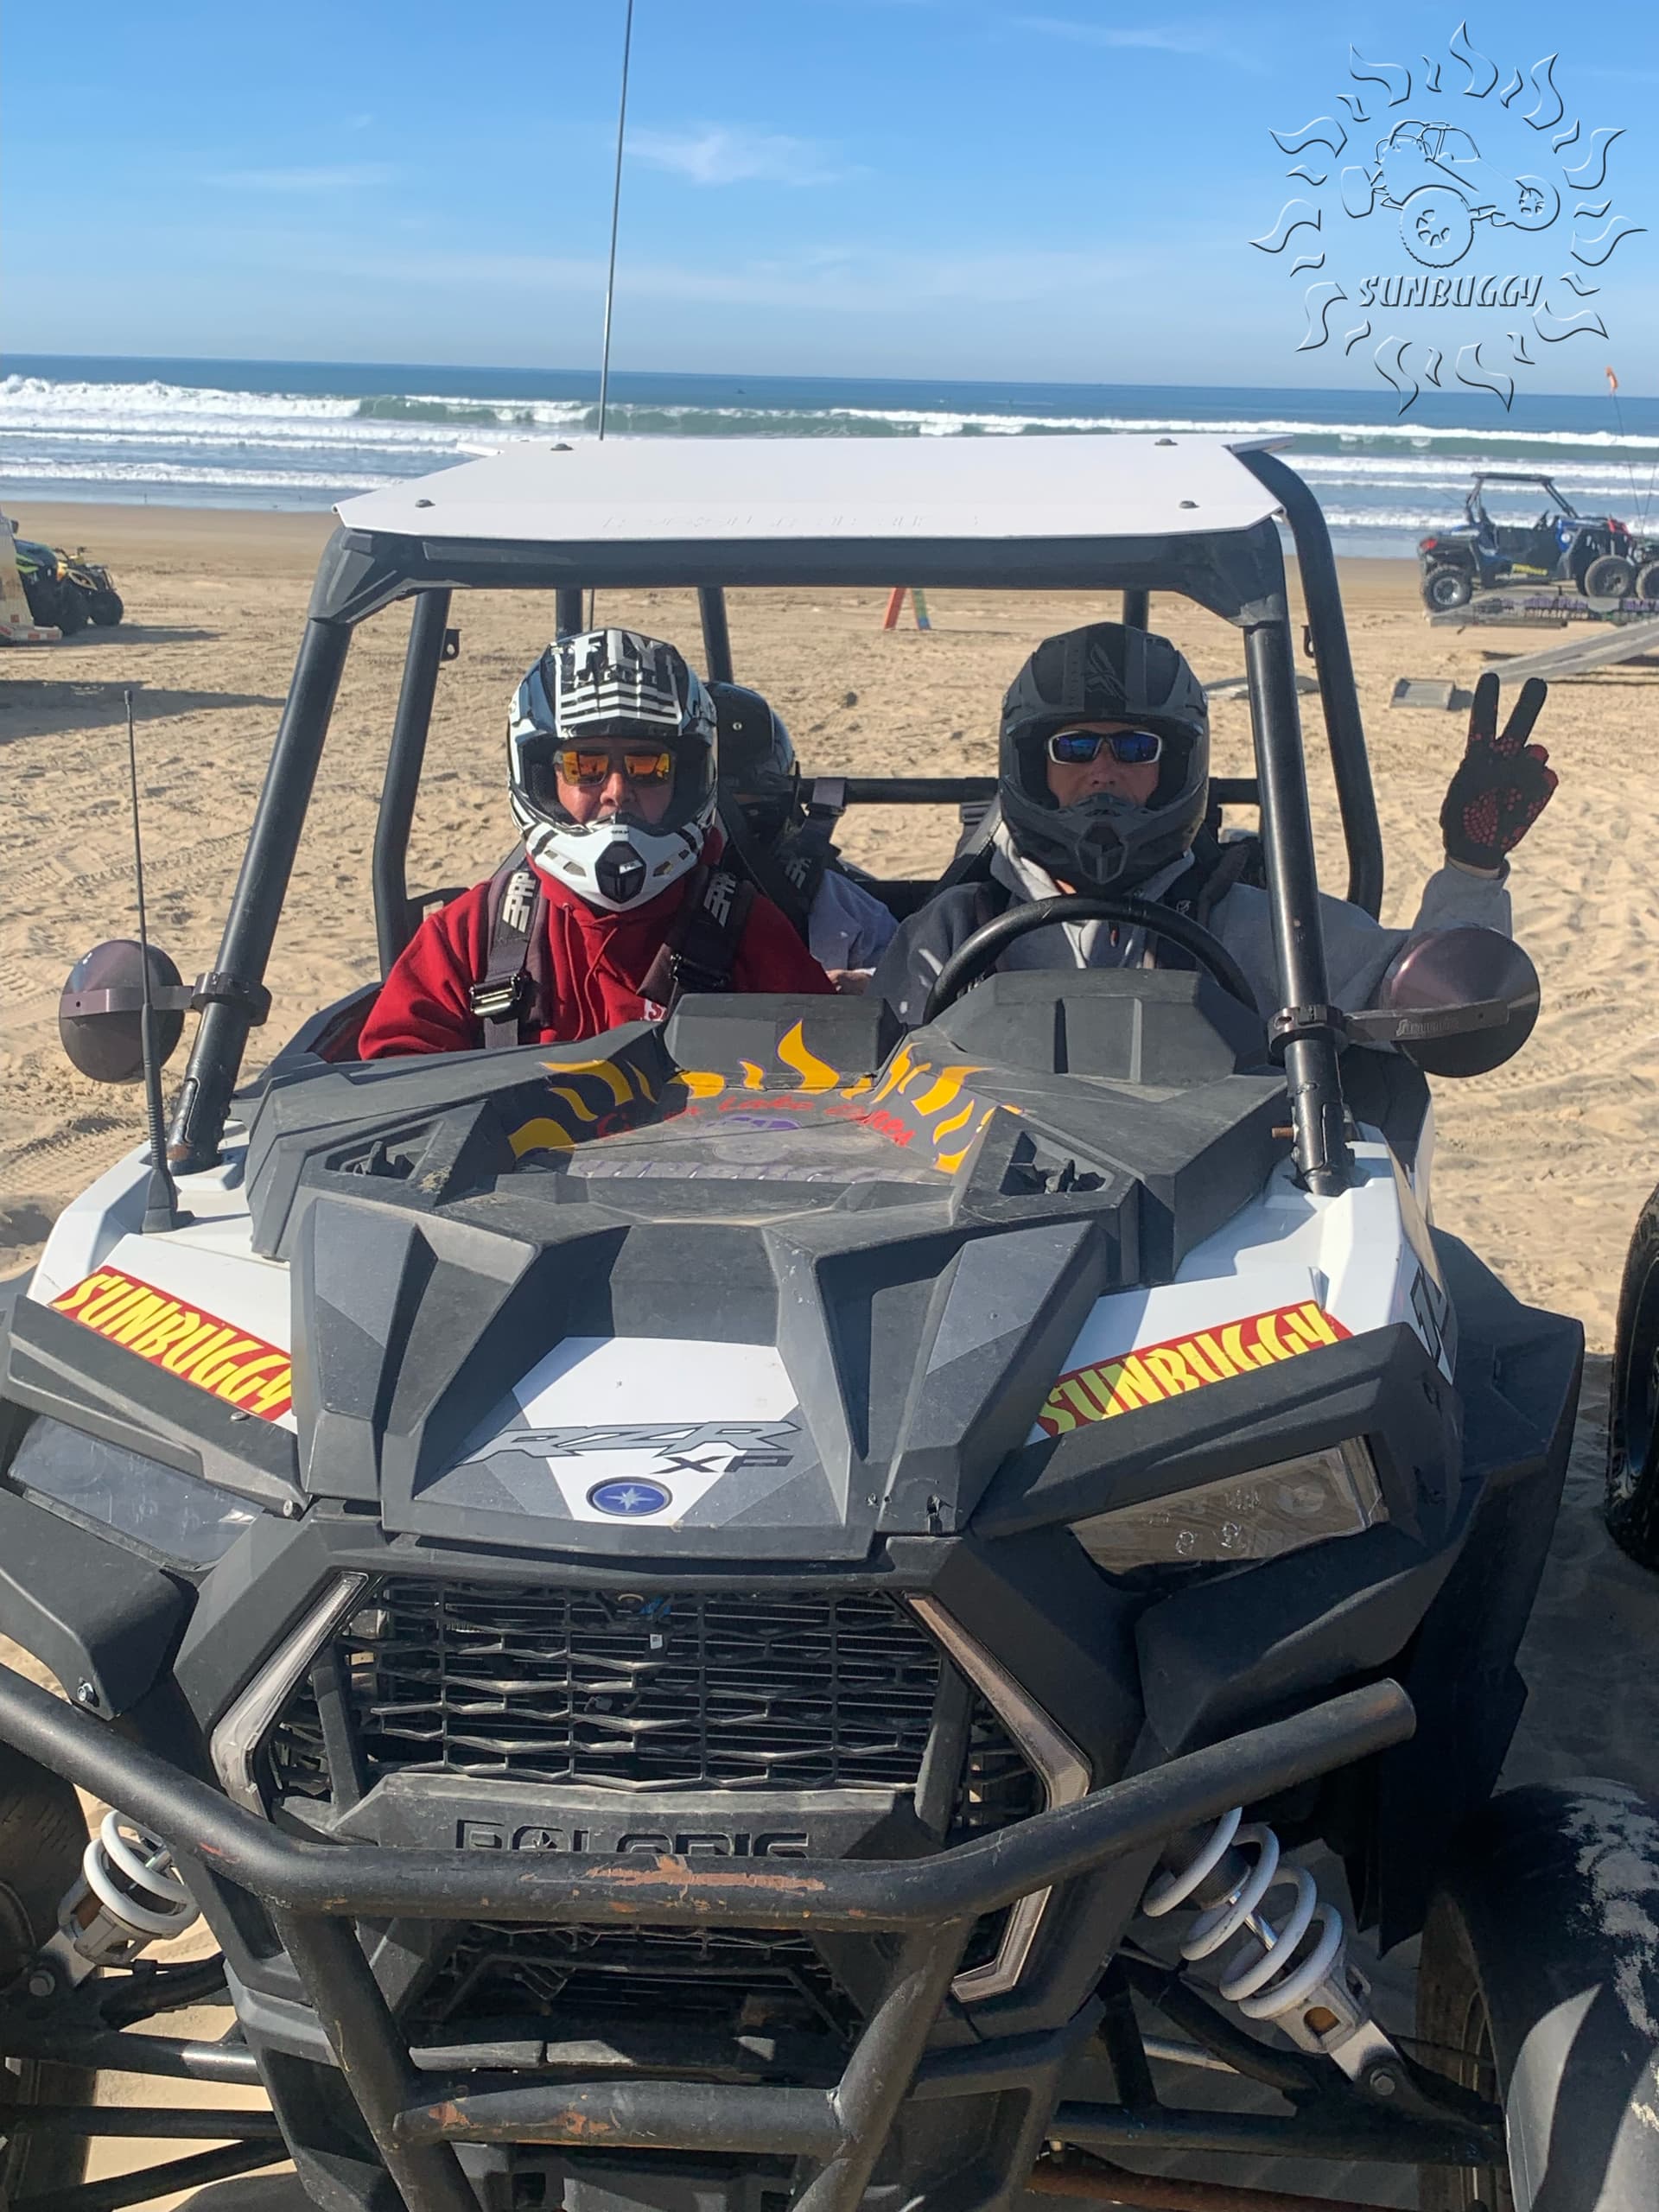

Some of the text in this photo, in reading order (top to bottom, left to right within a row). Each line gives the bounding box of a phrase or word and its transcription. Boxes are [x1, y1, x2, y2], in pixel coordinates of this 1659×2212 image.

[568, 630, 664, 674] FLY
[51, 1273, 291, 1414] SUNBUGGY
[1039, 1303, 1338, 1434] SUNBUGGY
[457, 1421, 802, 1465] RZR
[650, 1454, 795, 1474] XP
